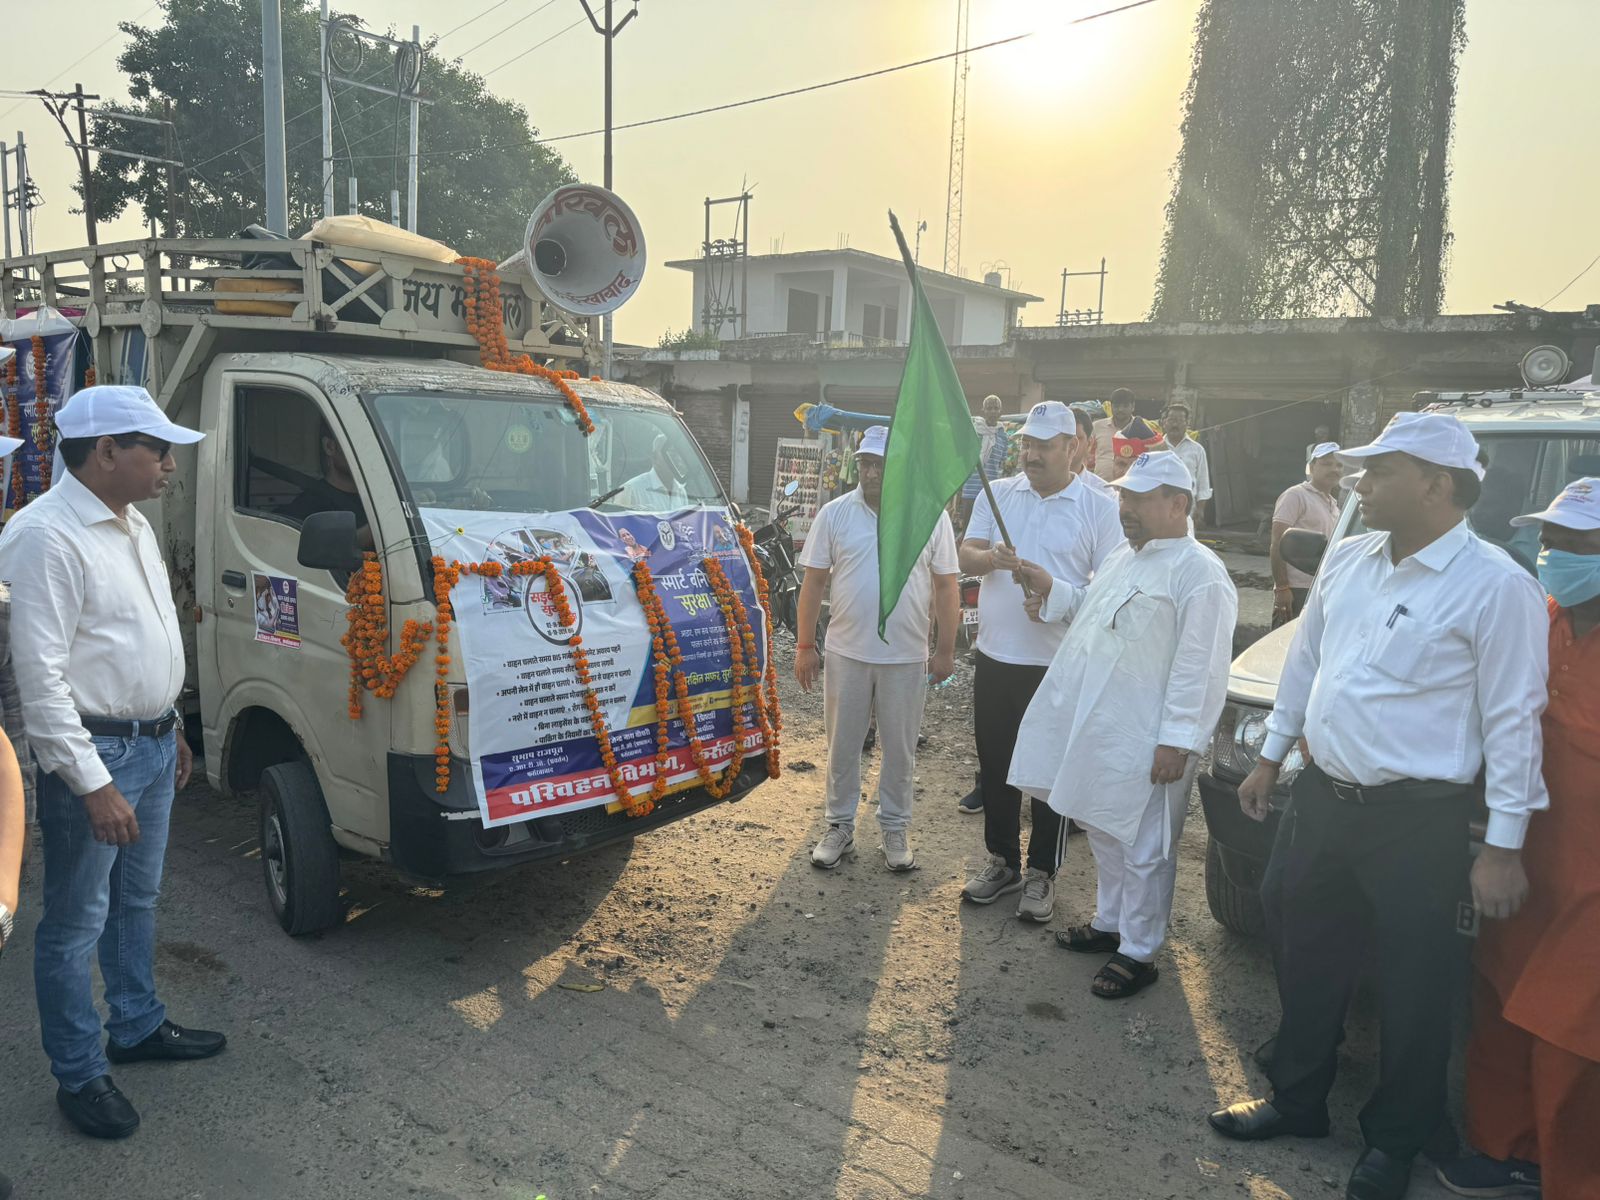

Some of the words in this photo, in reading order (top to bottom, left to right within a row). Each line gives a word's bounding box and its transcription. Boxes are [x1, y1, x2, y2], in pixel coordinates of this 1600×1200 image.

[402, 279, 444, 319] जय
[652, 568, 689, 591] स्मार्ट
[673, 593, 712, 616] सुरक्षा
[507, 660, 521, 668] वाहन
[522, 655, 538, 665] चलाते
[538, 655, 551, 663] समय
[520, 672, 535, 680] वाहन
[551, 667, 564, 675] समय
[501, 686, 517, 696] अपनी
[518, 684, 528, 694] लेन
[534, 681, 541, 692] ही
[541, 682, 555, 691] वाहन
[602, 672, 614, 680] वाहन
[524, 698, 538, 706] वाहन
[512, 712, 522, 722] नशे
[529, 710, 543, 719] वाहन
[538, 721, 550, 731] बिना
[573, 716, 580, 724] के
[557, 731, 564, 740] के
[582, 729, 590, 737] का
[512, 750, 535, 763] सुभाष
[537, 746, 564, 758] राजपूत
[509, 773, 613, 806] परिवहन
